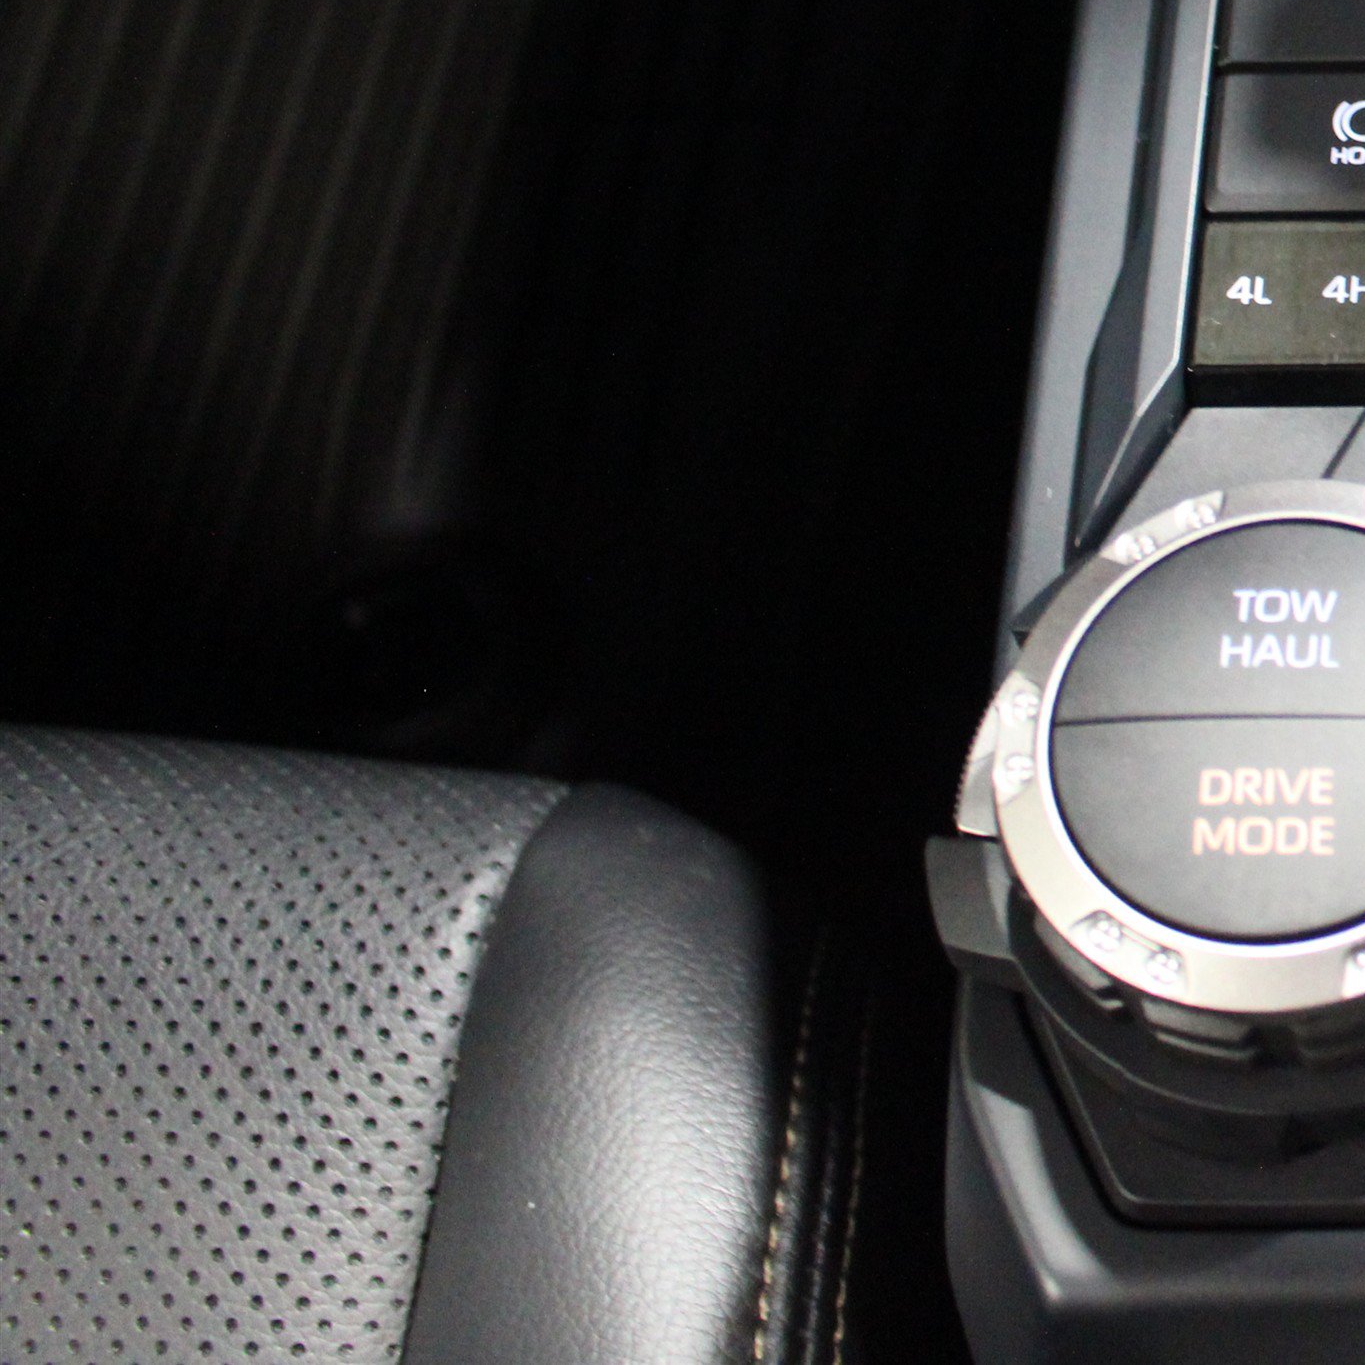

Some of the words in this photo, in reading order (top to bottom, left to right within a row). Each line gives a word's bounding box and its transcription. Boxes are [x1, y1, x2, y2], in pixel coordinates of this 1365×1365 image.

[1226, 275, 1272, 306] 4L
[1233, 589, 1338, 623] TOW
[1219, 634, 1340, 668] HAUL
[1198, 768, 1335, 806] DRIVE
[1190, 817, 1336, 857] MODE
